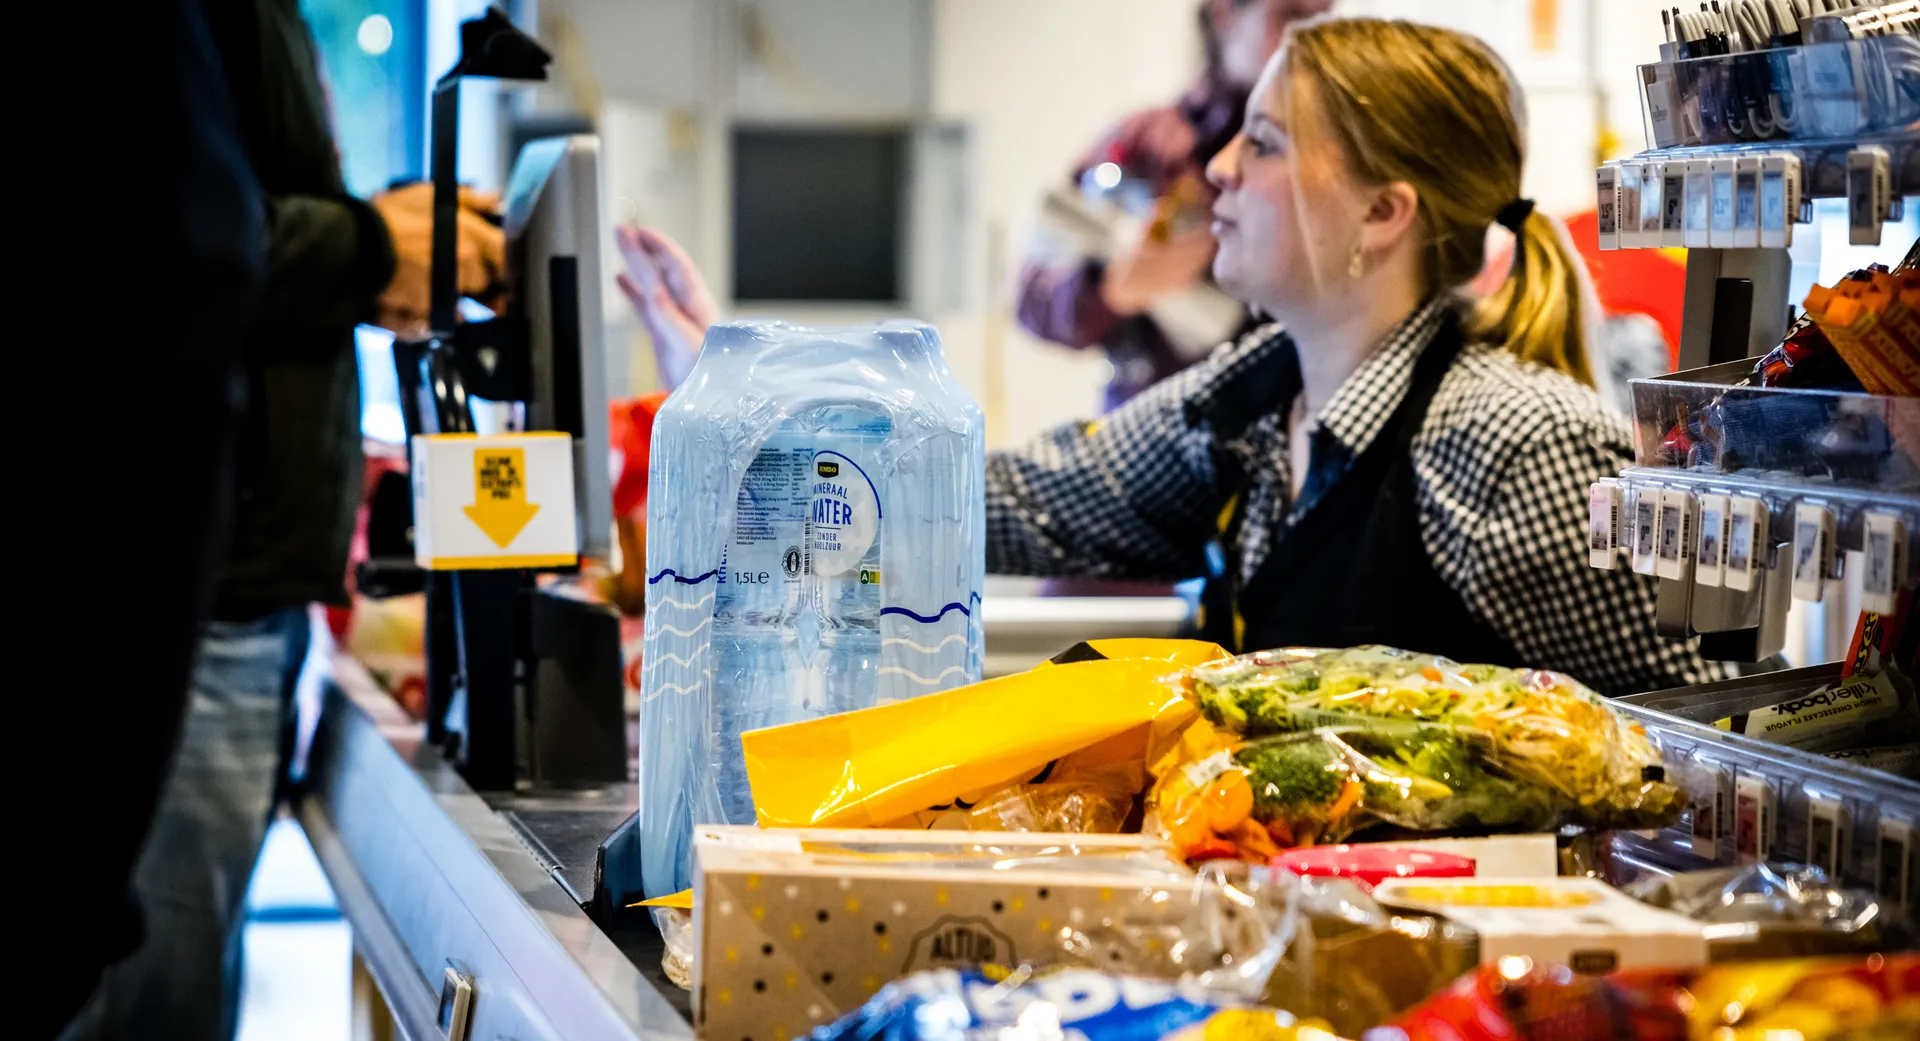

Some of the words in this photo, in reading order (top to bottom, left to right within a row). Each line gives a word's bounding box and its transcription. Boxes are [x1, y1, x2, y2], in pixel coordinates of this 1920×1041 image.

[816, 532, 837, 542] ZONDER
[1854, 698, 1882, 708] LEMON
[1803, 704, 1852, 723] CHEESECAKE
[1764, 717, 1802, 732] FLAVOUR
